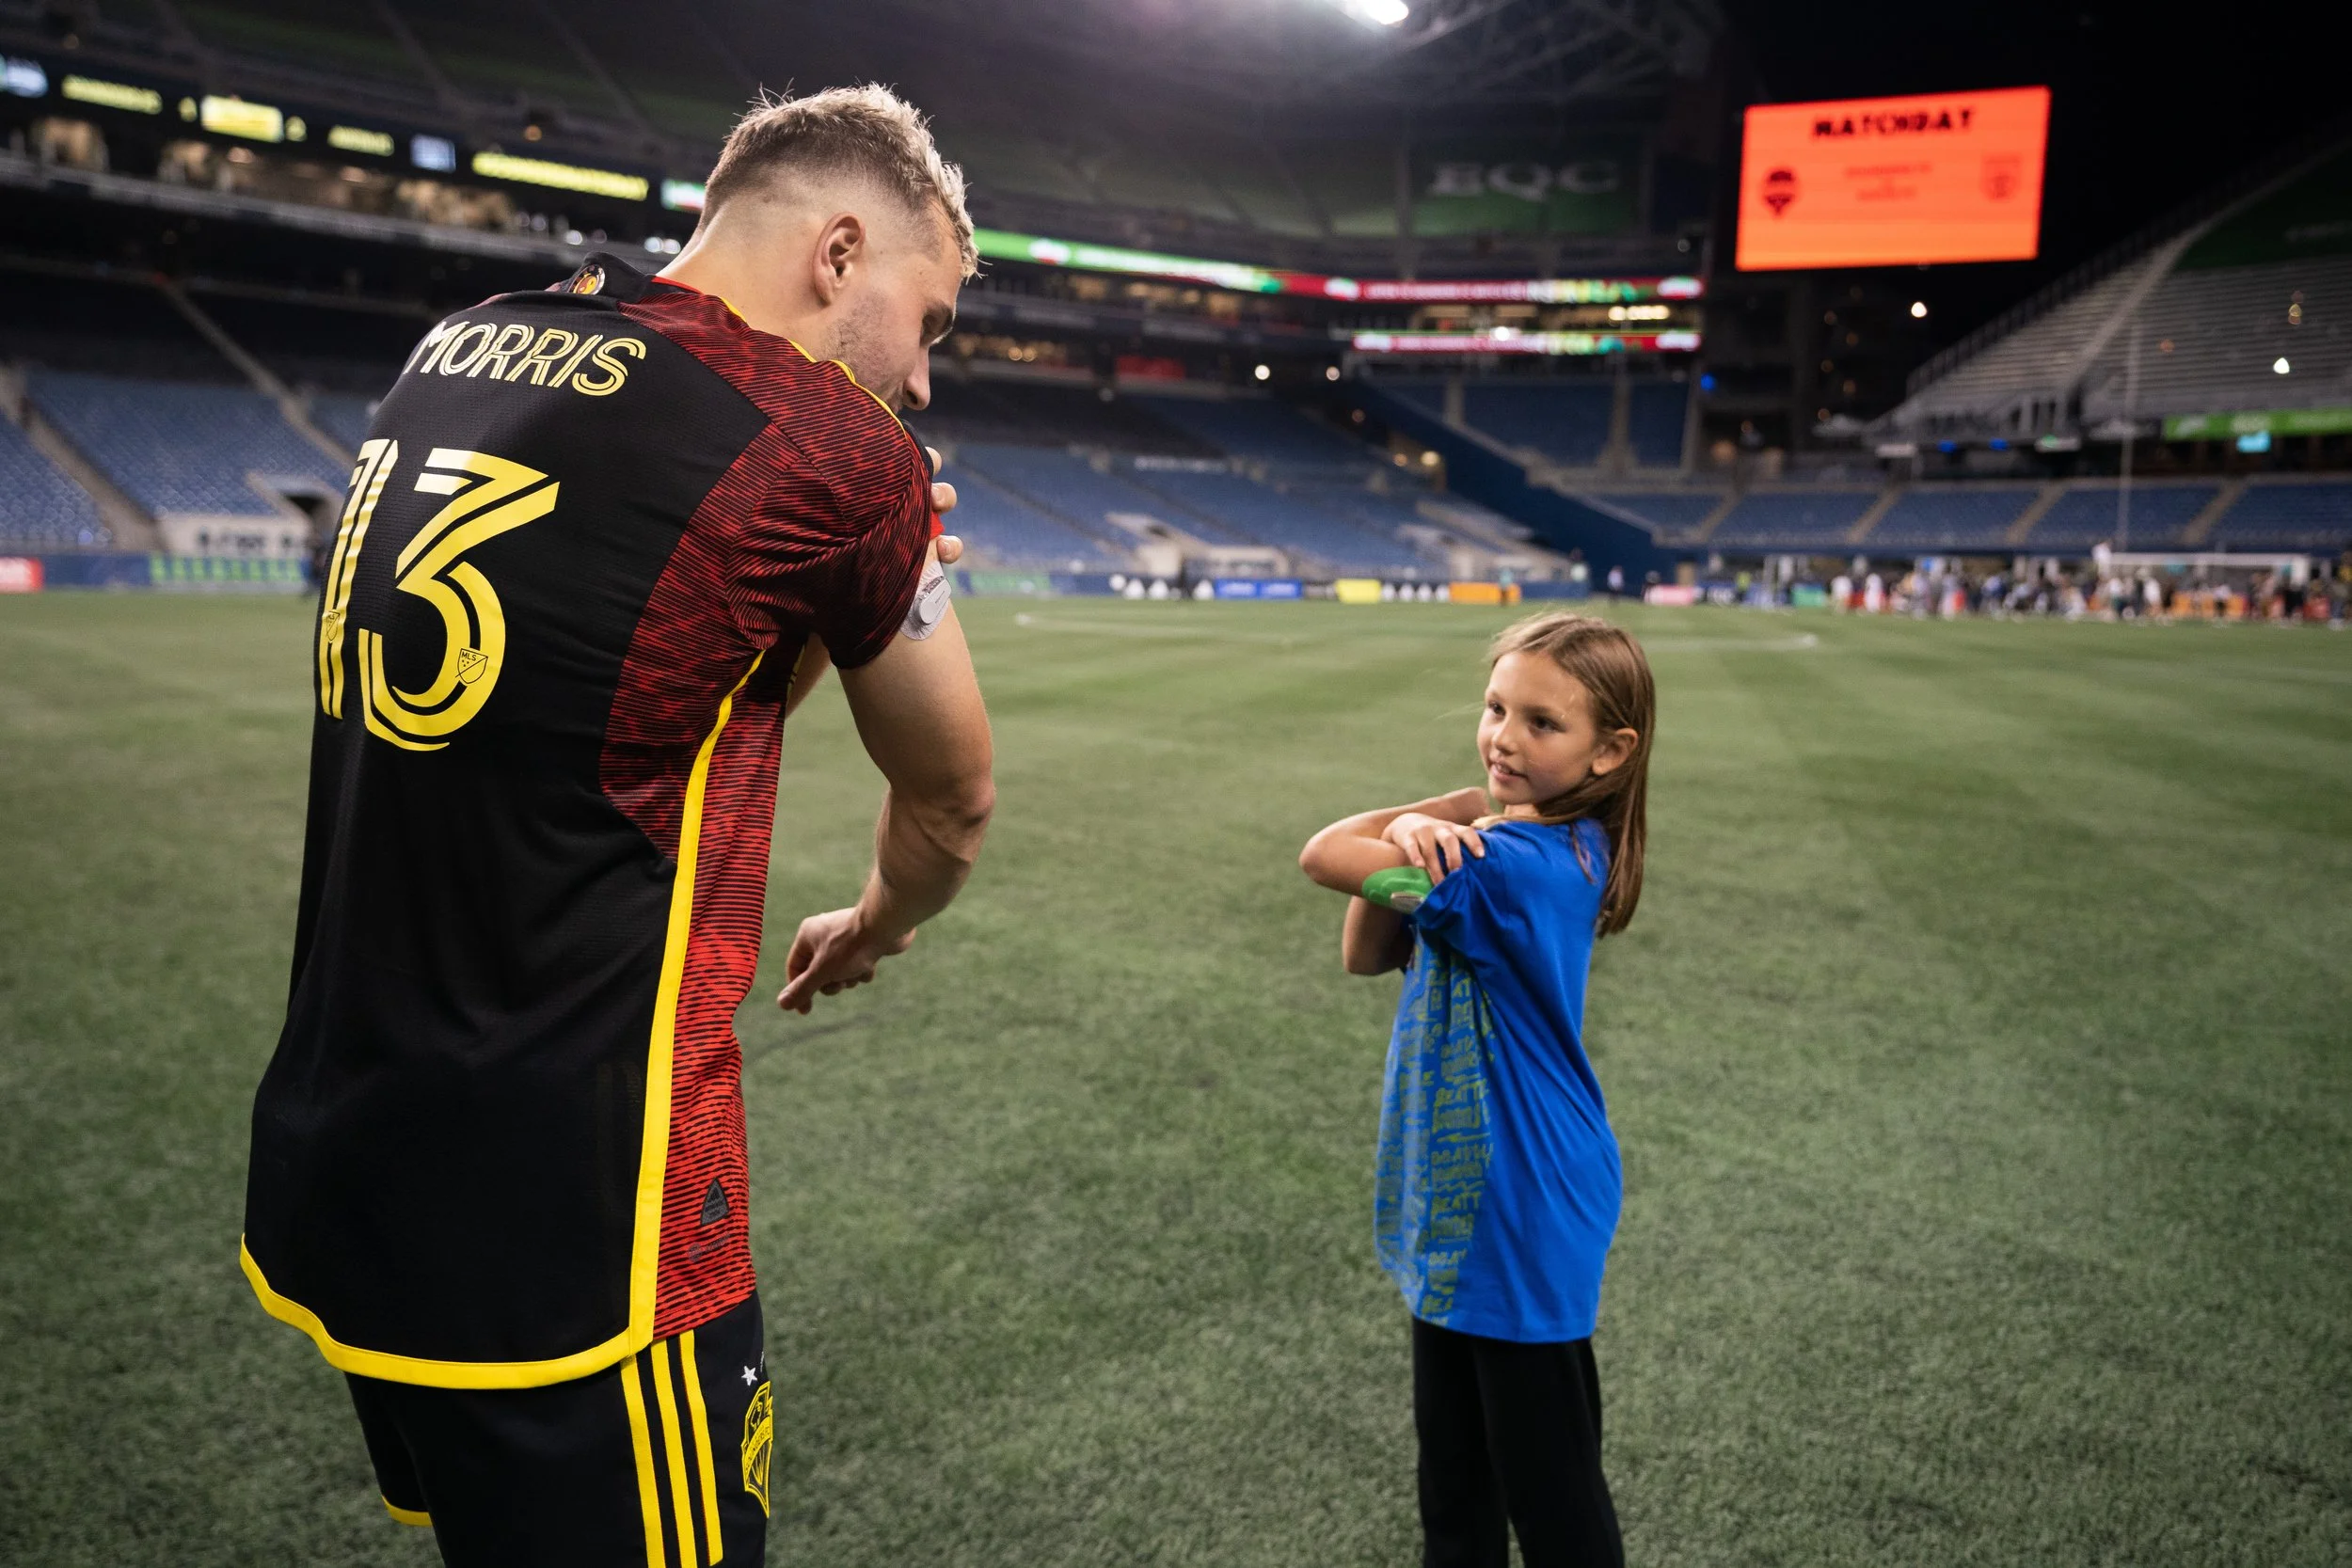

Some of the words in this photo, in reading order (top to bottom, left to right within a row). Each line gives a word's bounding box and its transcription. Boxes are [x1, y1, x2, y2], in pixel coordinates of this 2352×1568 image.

[403, 321, 646, 396] MORRIS
[319, 438, 561, 752] 13
[461, 651, 477, 661] MLS
